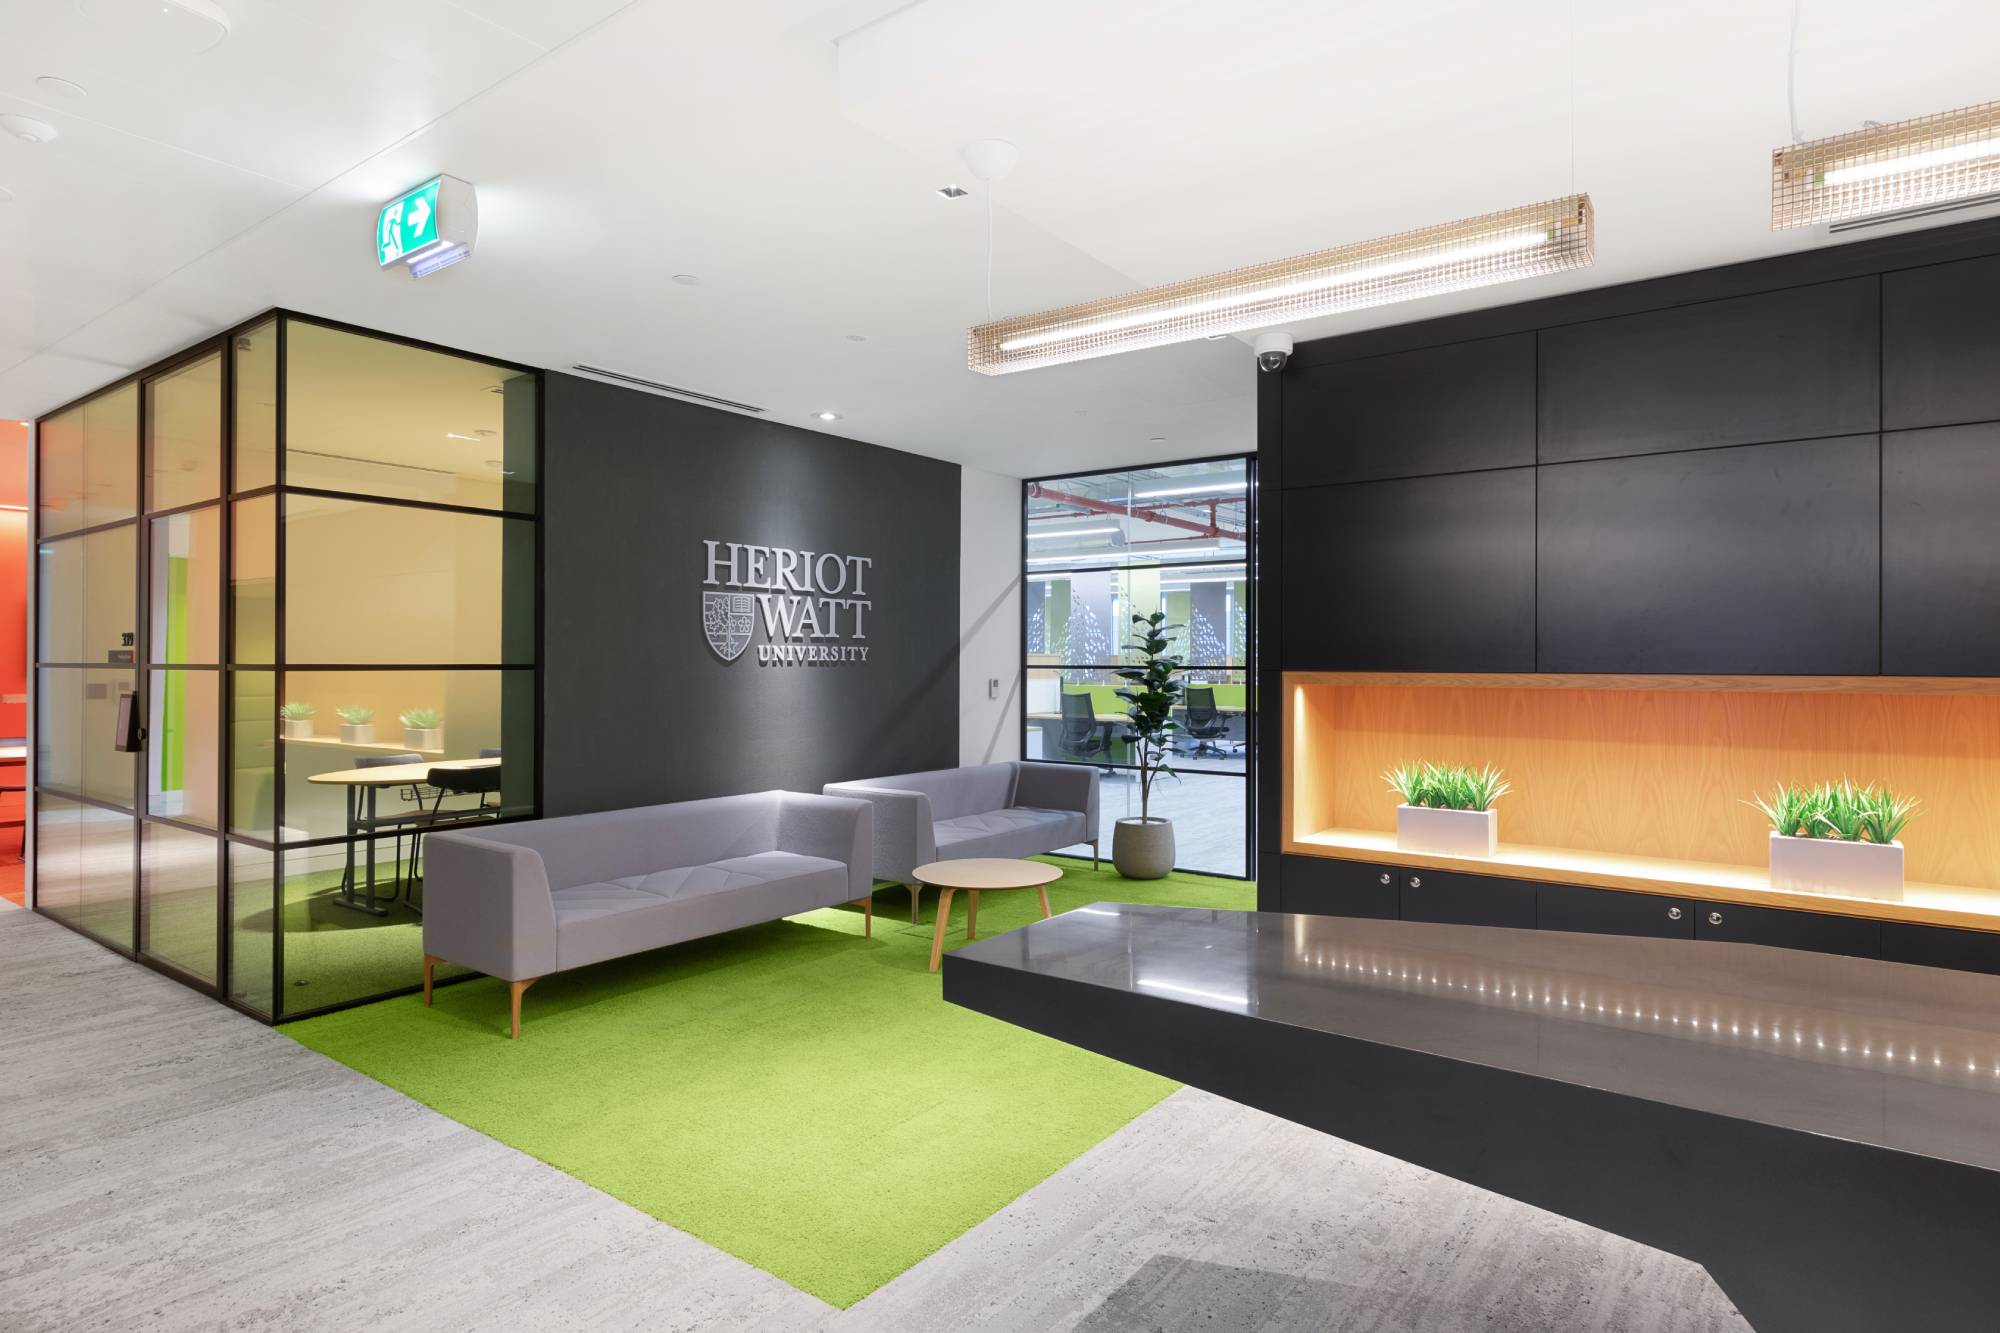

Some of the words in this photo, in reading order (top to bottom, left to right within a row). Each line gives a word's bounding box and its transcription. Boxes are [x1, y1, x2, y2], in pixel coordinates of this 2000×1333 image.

[702, 539, 872, 595] HERIOT
[755, 593, 872, 639] WATT
[757, 644, 869, 661] UNIVERSITY
